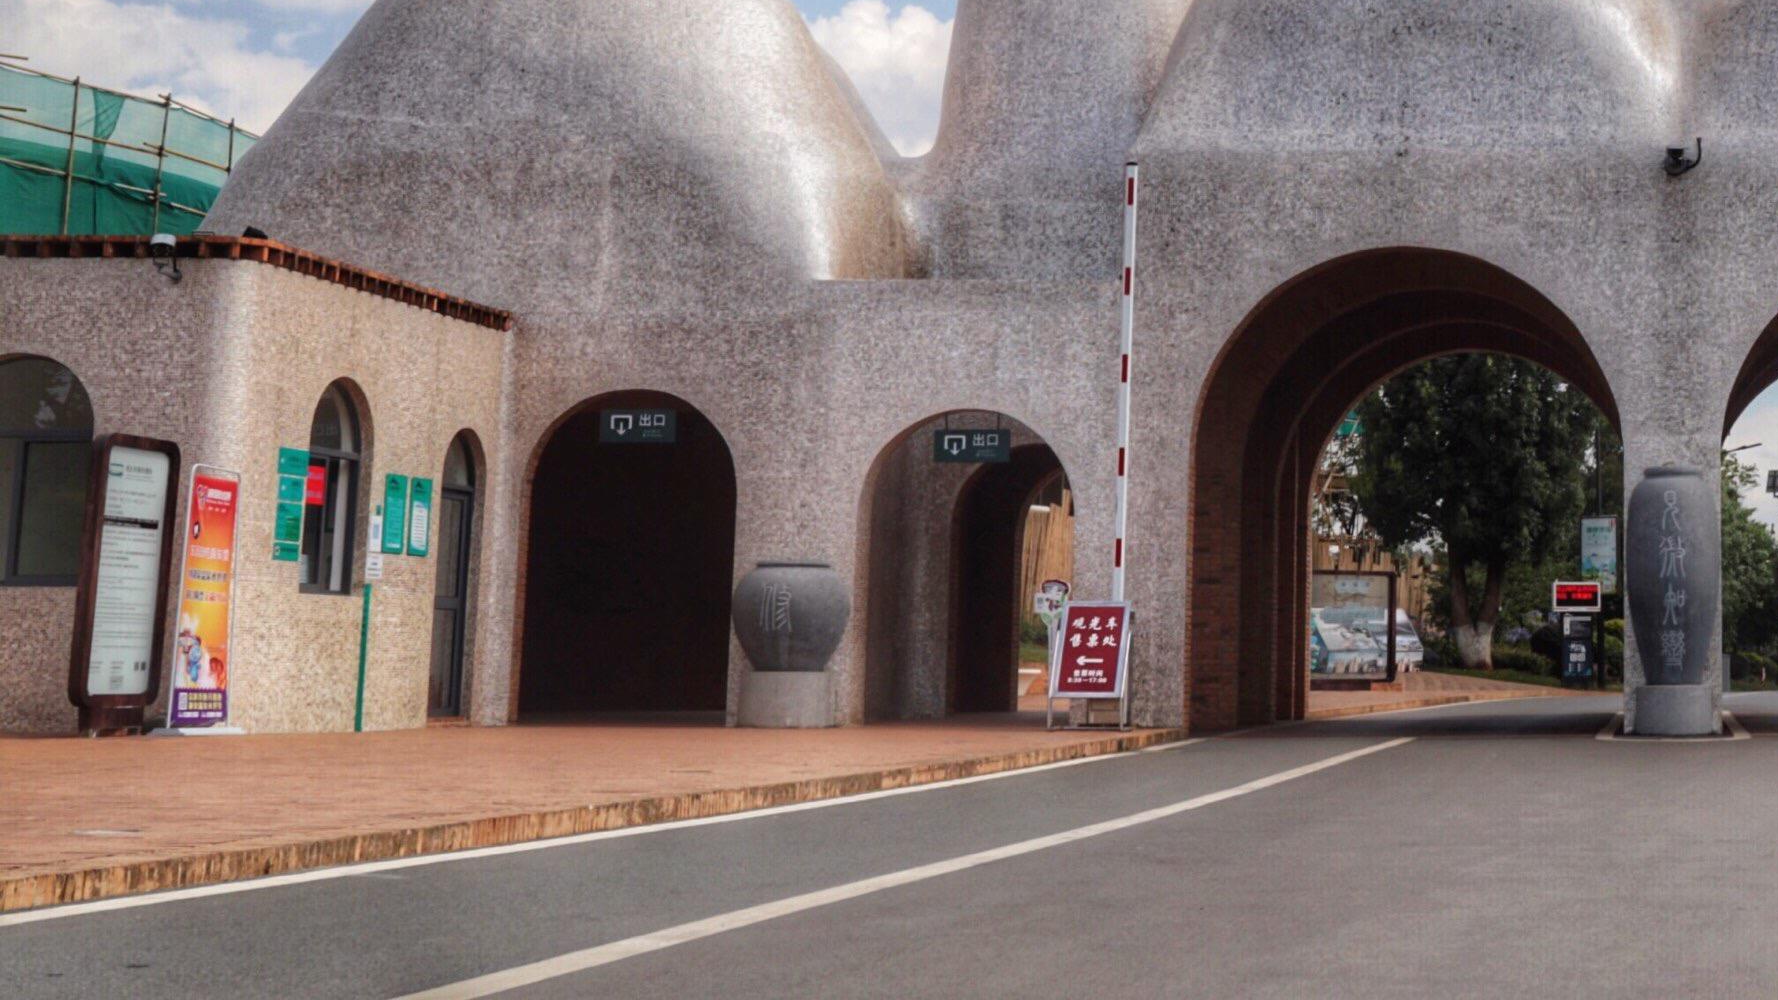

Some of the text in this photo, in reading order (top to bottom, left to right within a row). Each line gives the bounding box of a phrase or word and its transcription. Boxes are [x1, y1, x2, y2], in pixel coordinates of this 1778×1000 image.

[639, 414, 666, 427] 出口
[972, 433, 999, 447] 出口
[1072, 616, 1118, 630] 观光车
[1069, 633, 1117, 647] 售票处
